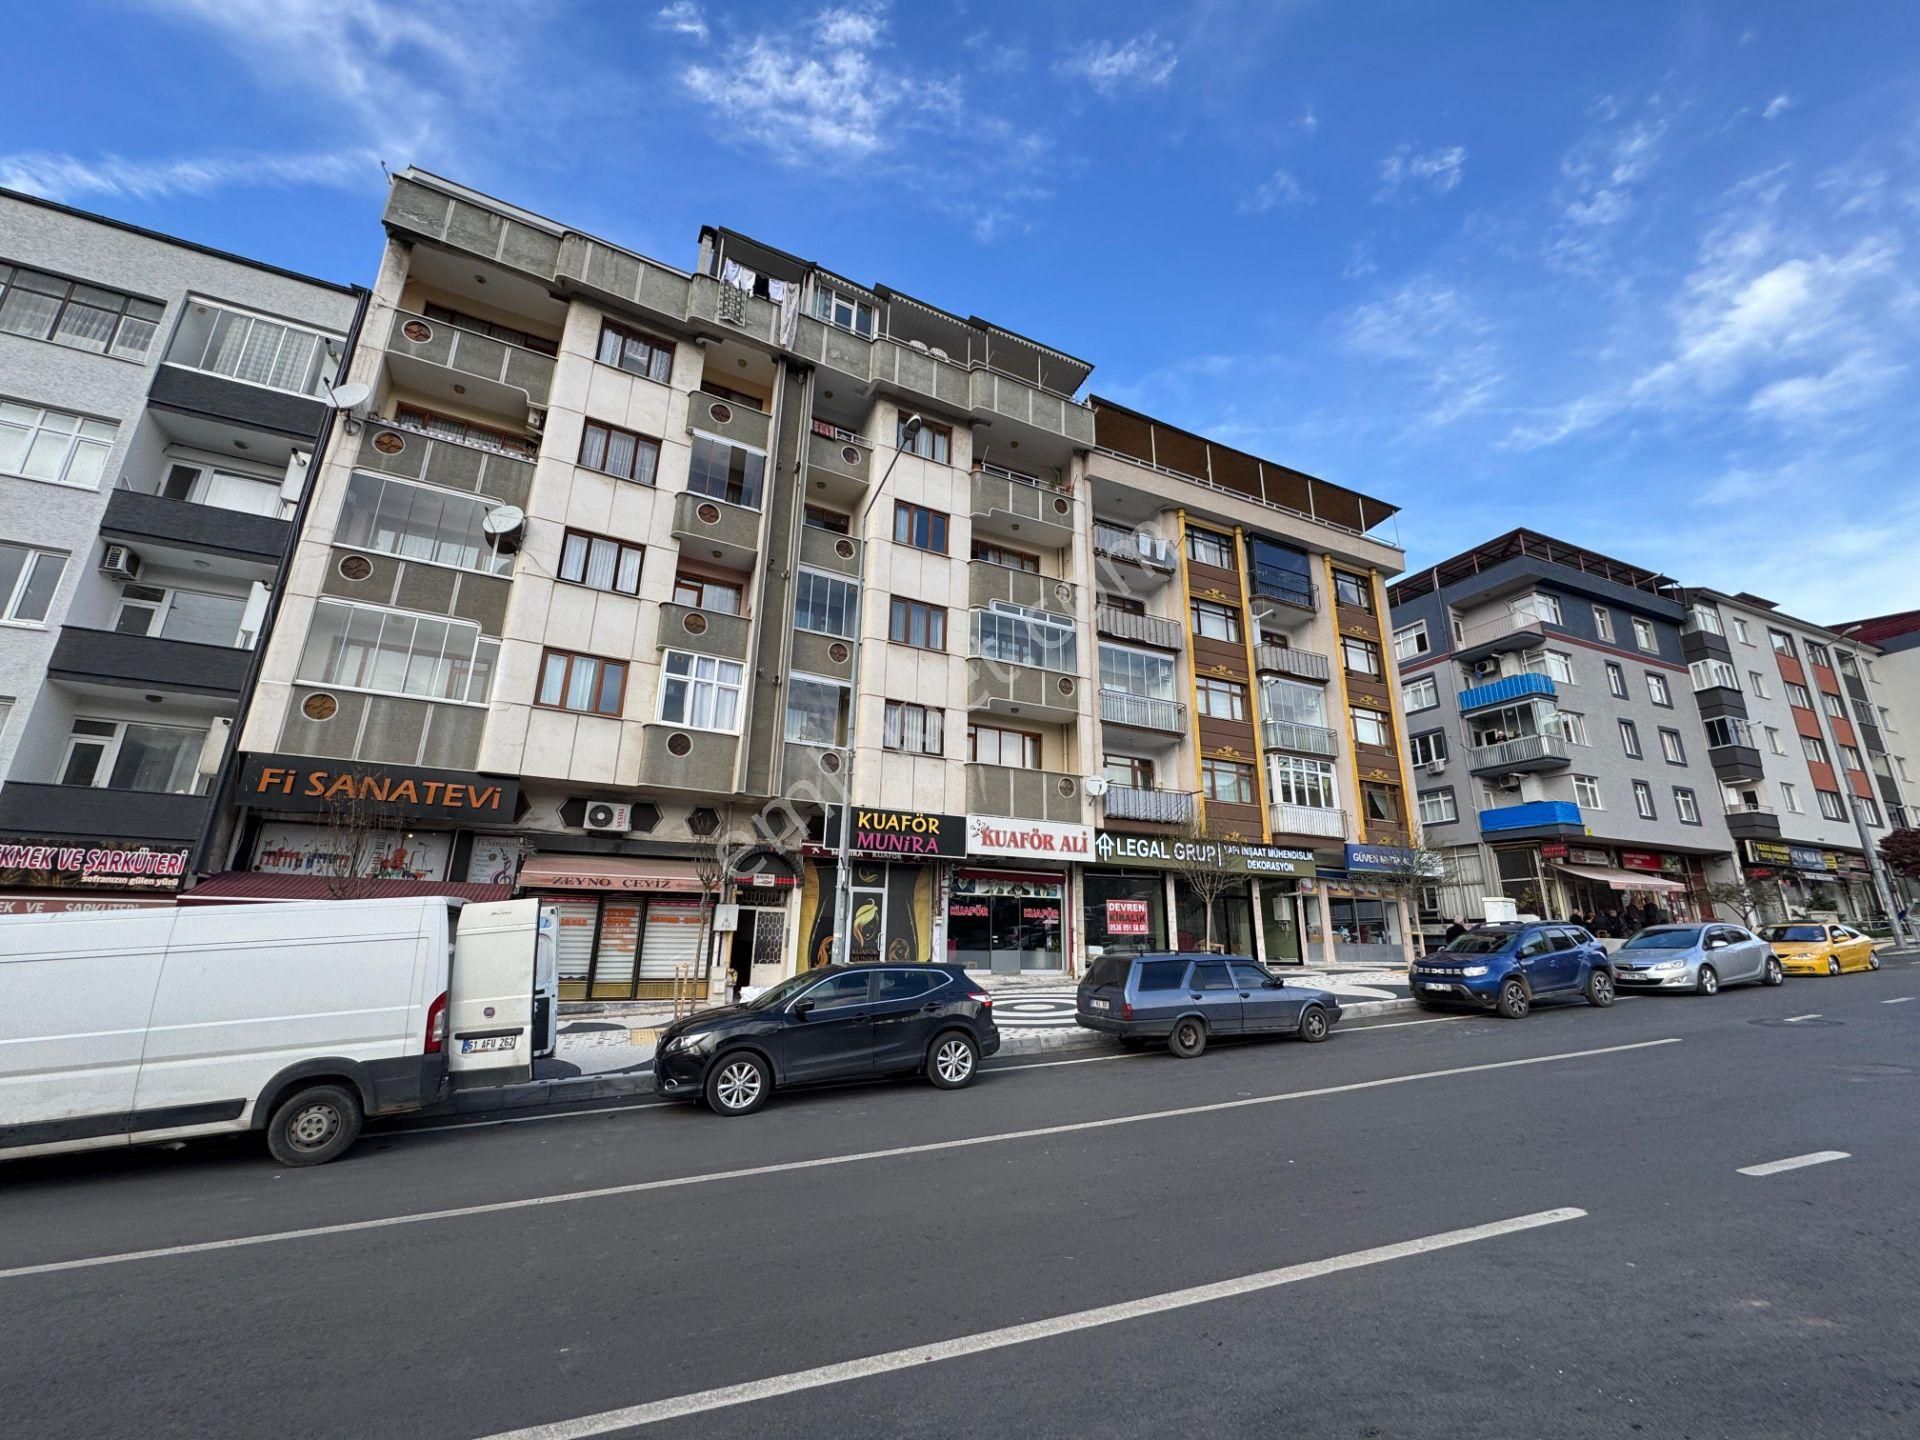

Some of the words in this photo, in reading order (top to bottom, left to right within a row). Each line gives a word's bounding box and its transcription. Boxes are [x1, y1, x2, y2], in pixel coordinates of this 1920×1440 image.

[857, 811, 940, 835] KUAFÖR
[981, 827, 1056, 852] KUAFÖR
[1060, 831, 1089, 854] ALİ
[1116, 837, 1170, 860] LEGAL
[1173, 842, 1216, 863] GRUP
[0, 844, 58, 870] KMEK
[57, 848, 85, 872] VE
[83, 847, 189, 876] ŞARKÜTERİ
[1352, 852, 1379, 864] GÜVEN
[1246, 859, 1295, 872] DEKORASYON
[128, 876, 154, 886] gülen
[154, 878, 179, 887] yüzü
[552, 876, 612, 887] ZEYNO
[26, 902, 45, 912] VE
[950, 904, 989, 917] KUAFÖR
[1023, 907, 1059, 919] KUAFÖR
[1109, 902, 1145, 912] DEVREN
